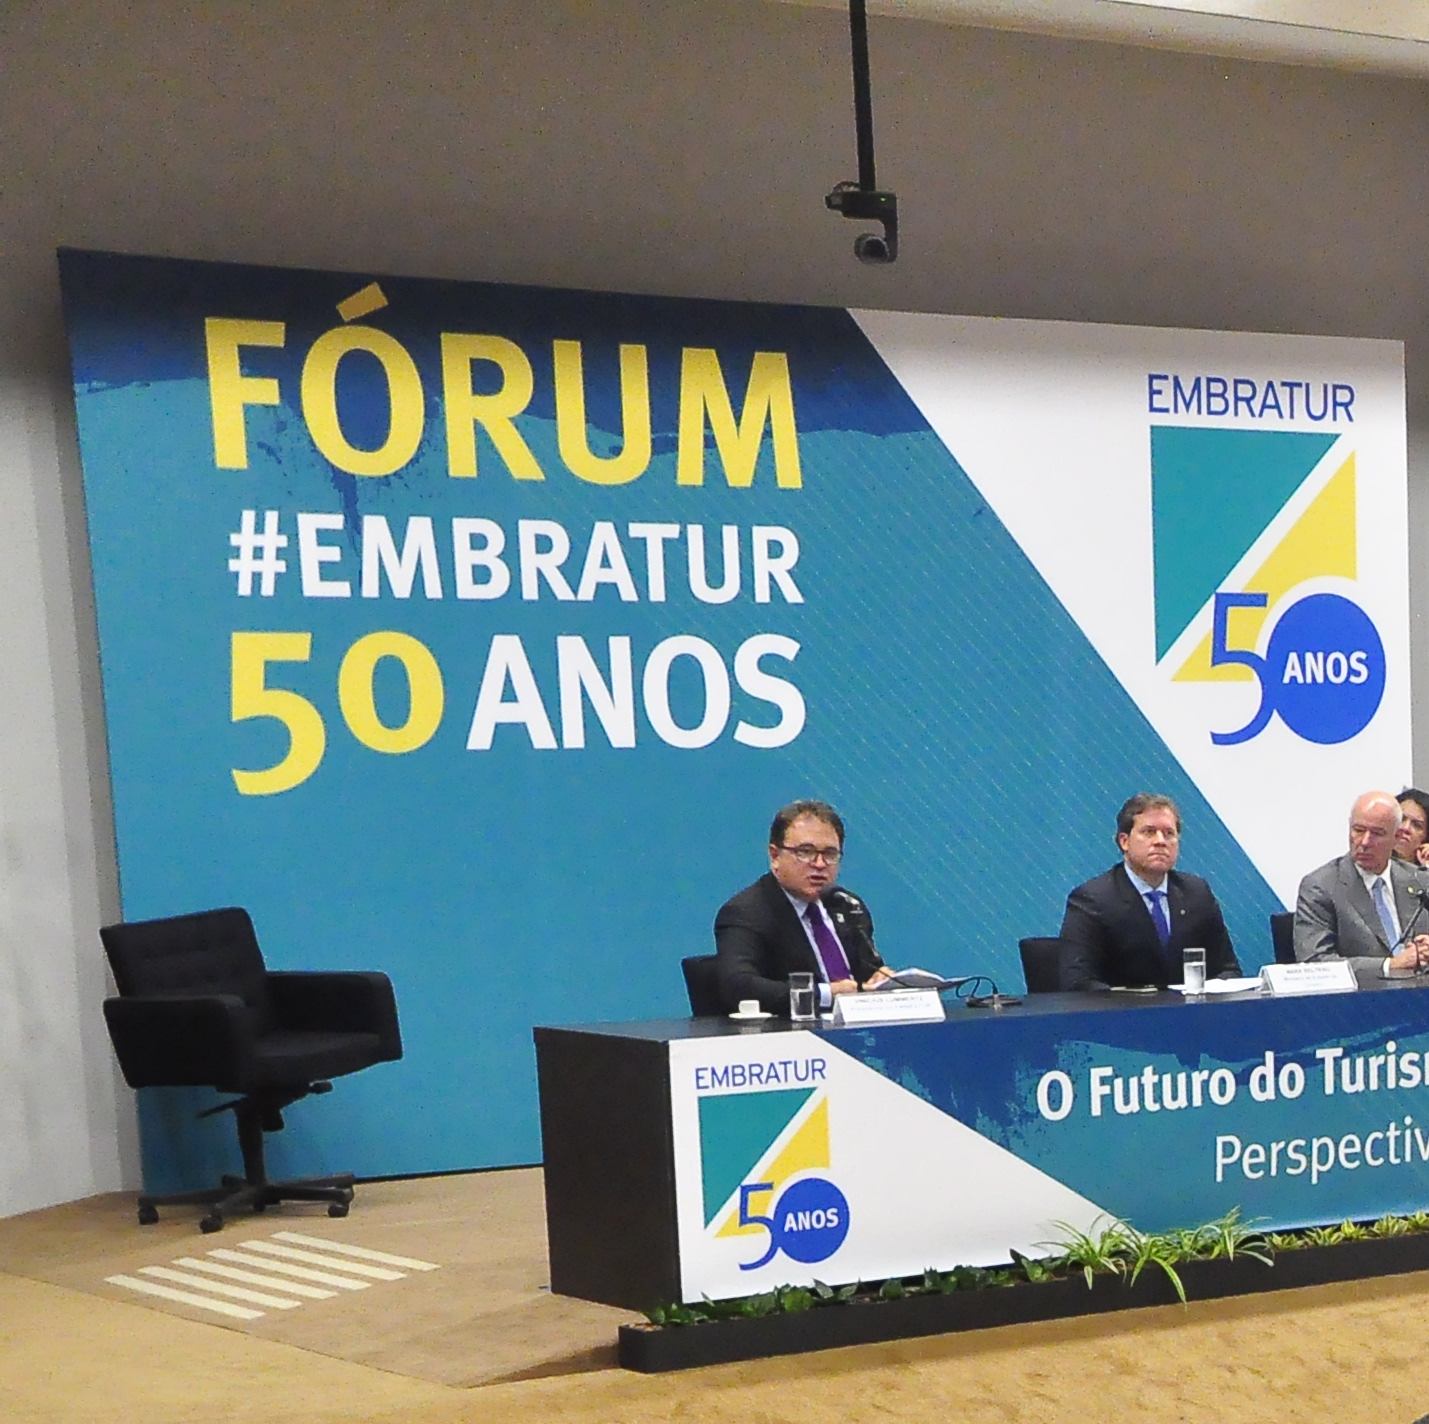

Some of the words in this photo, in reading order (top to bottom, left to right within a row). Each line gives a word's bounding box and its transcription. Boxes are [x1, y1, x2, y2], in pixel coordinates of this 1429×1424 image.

[205, 282, 802, 489] FÓRUM
[1148, 373, 1355, 422] EMBRATUR
[228, 510, 804, 604] #EMBRATUR
[1283, 651, 1369, 685] ANOS
[230, 631, 445, 796] 50
[465, 634, 806, 750] ANOS
[695, 1058, 827, 1090] EMBRATUR
[1036, 1070, 1074, 1121] O
[1090, 1065, 1236, 1117] Futuro
[1249, 1051, 1305, 1102] do
[784, 1208, 839, 1232] ANOS
